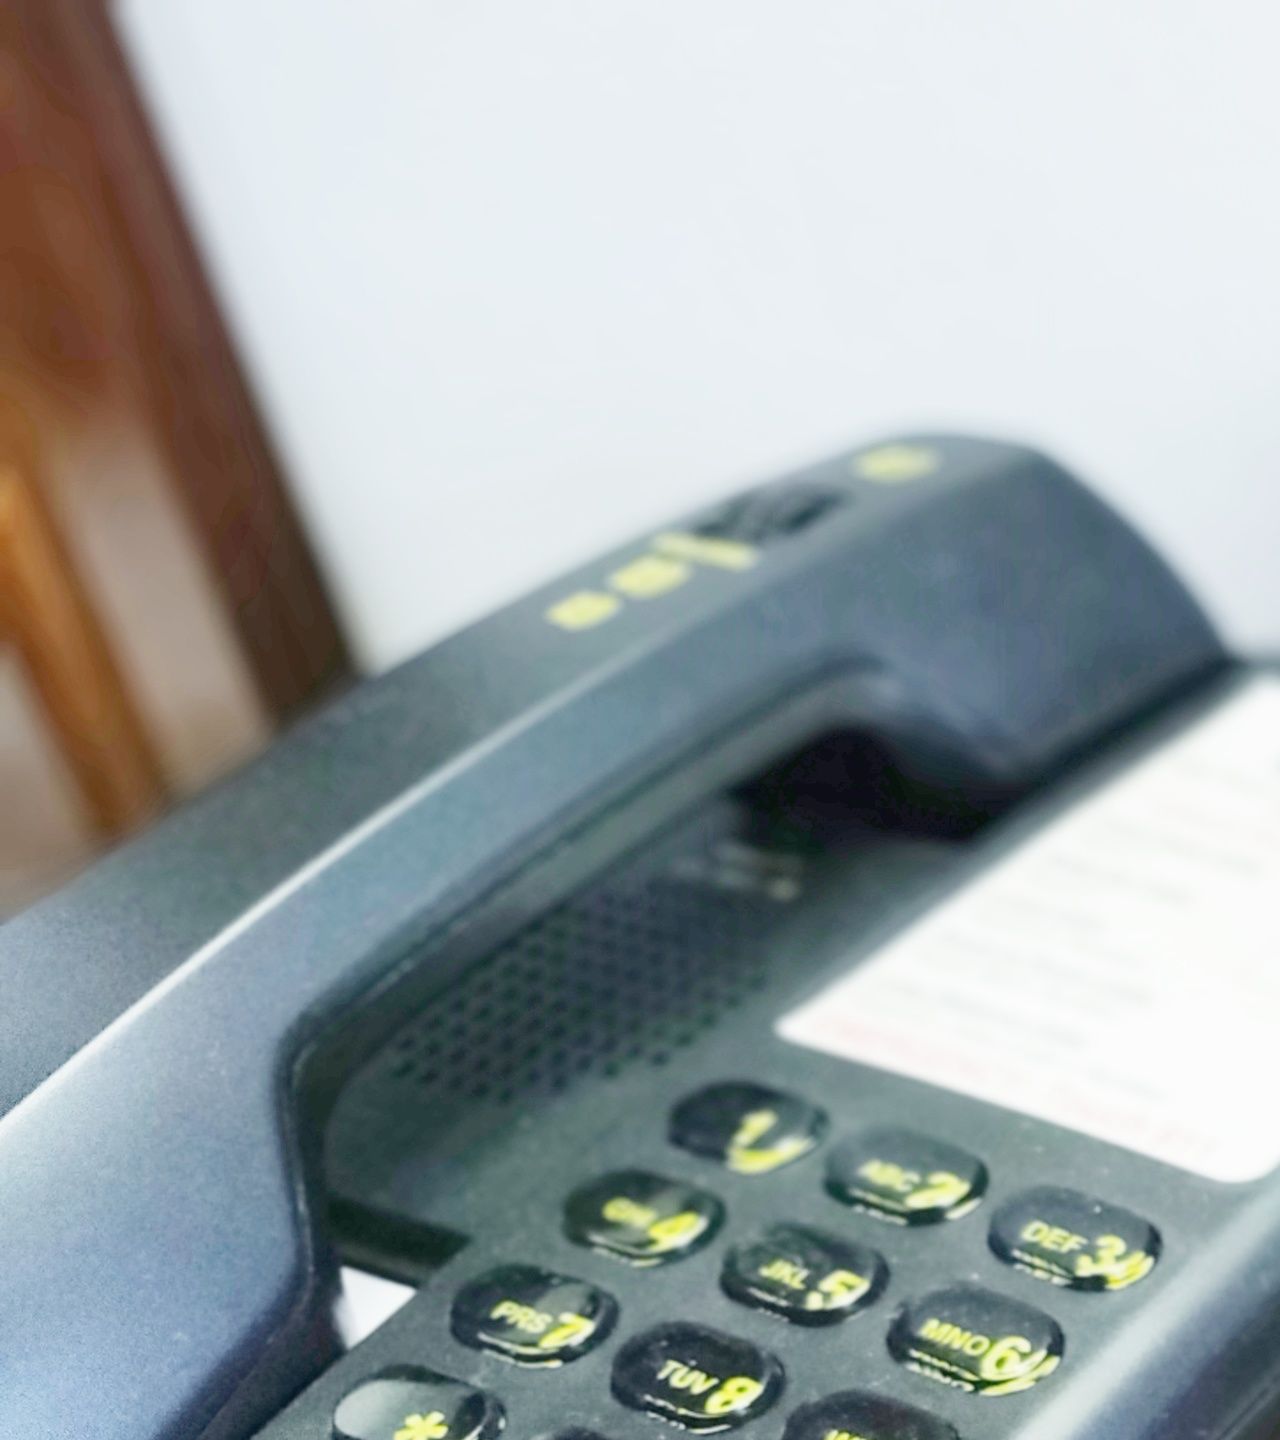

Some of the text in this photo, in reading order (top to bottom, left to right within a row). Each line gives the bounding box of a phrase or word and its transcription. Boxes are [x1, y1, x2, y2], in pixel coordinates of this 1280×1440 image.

[1021, 1219, 1127, 1276] DEF 3
[804, 1269, 870, 1311] 5
[490, 1300, 596, 1348] PRS 7
[918, 1317, 1034, 1381] MNO 6
[656, 1359, 764, 1415] TUV 8
